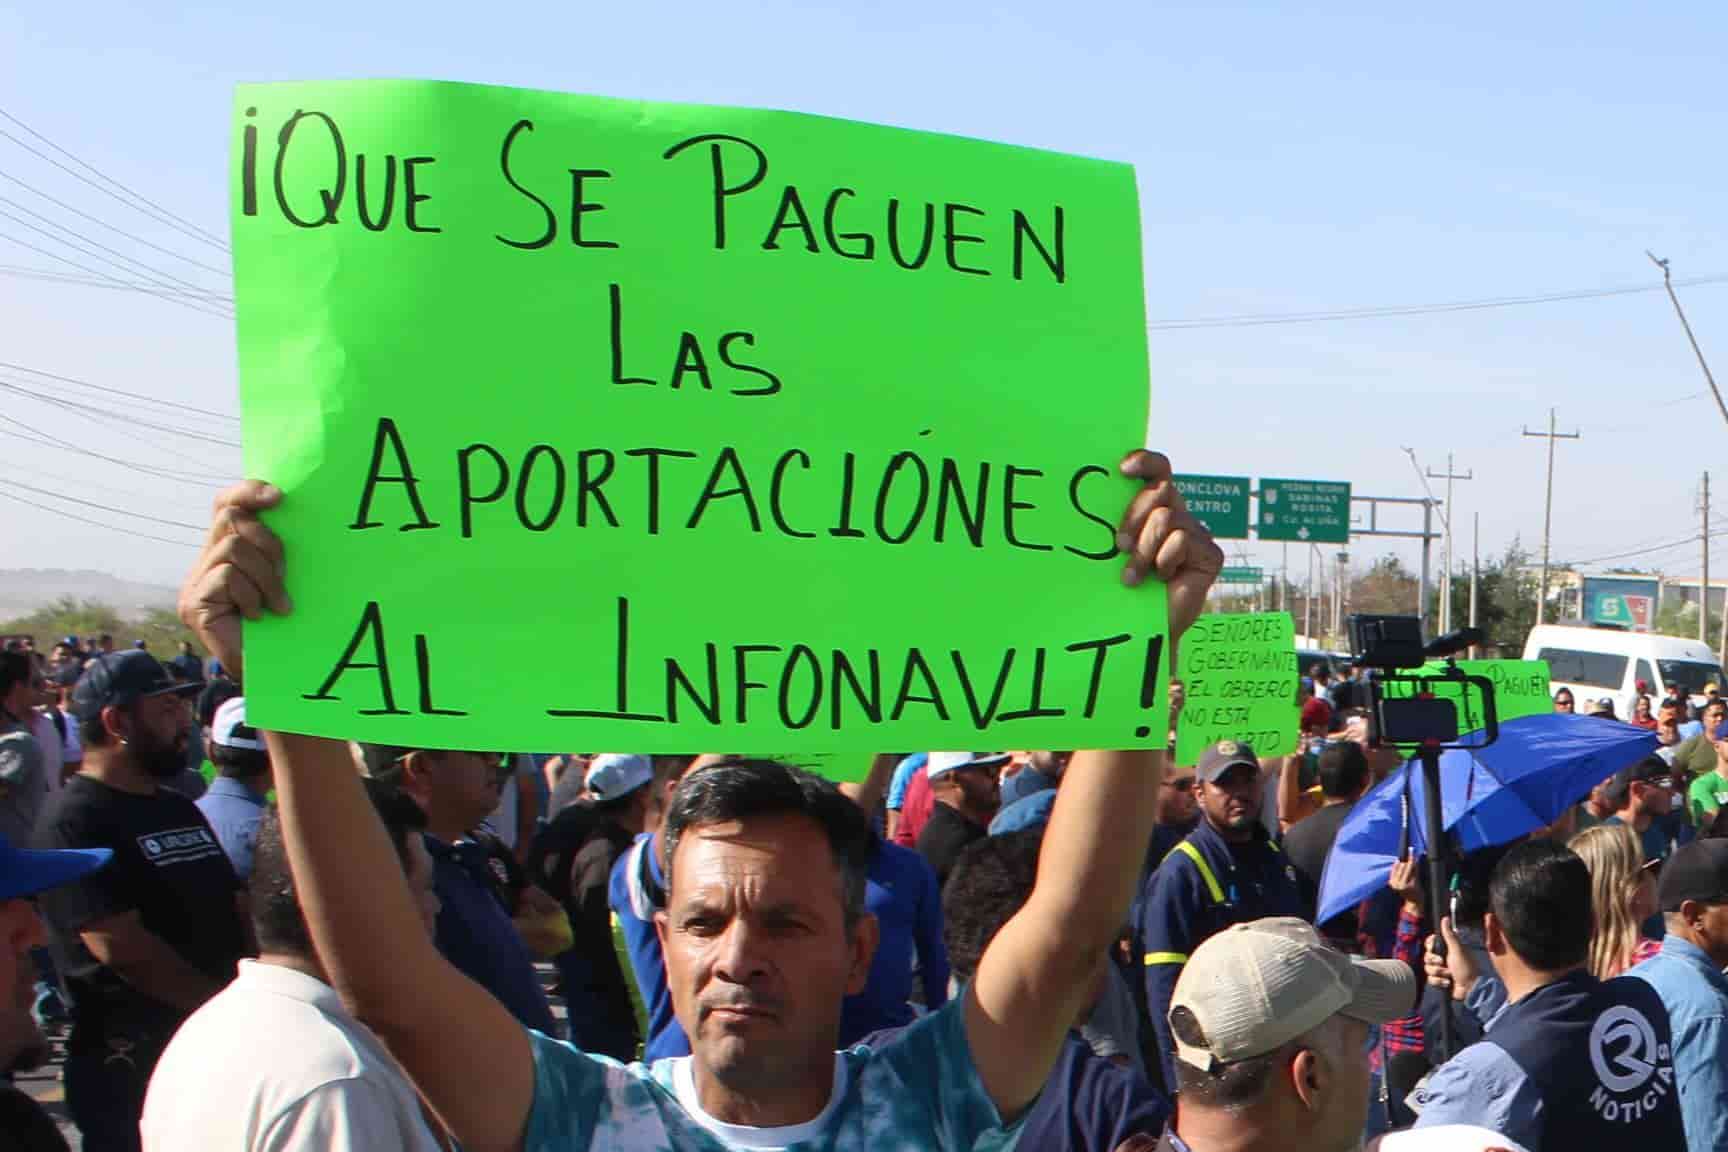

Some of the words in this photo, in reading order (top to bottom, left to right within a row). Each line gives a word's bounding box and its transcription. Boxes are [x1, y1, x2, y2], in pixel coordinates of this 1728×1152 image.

[496, 119, 619, 249] SE
[663, 134, 1065, 283] PAGUEN
[610, 284, 781, 396] LAS
[1186, 500, 1231, 513] ENTRO
[303, 601, 467, 716] AL
[547, 597, 1163, 737] INFONAVIT!
[1589, 1043, 1673, 1123] NOTICIAS
